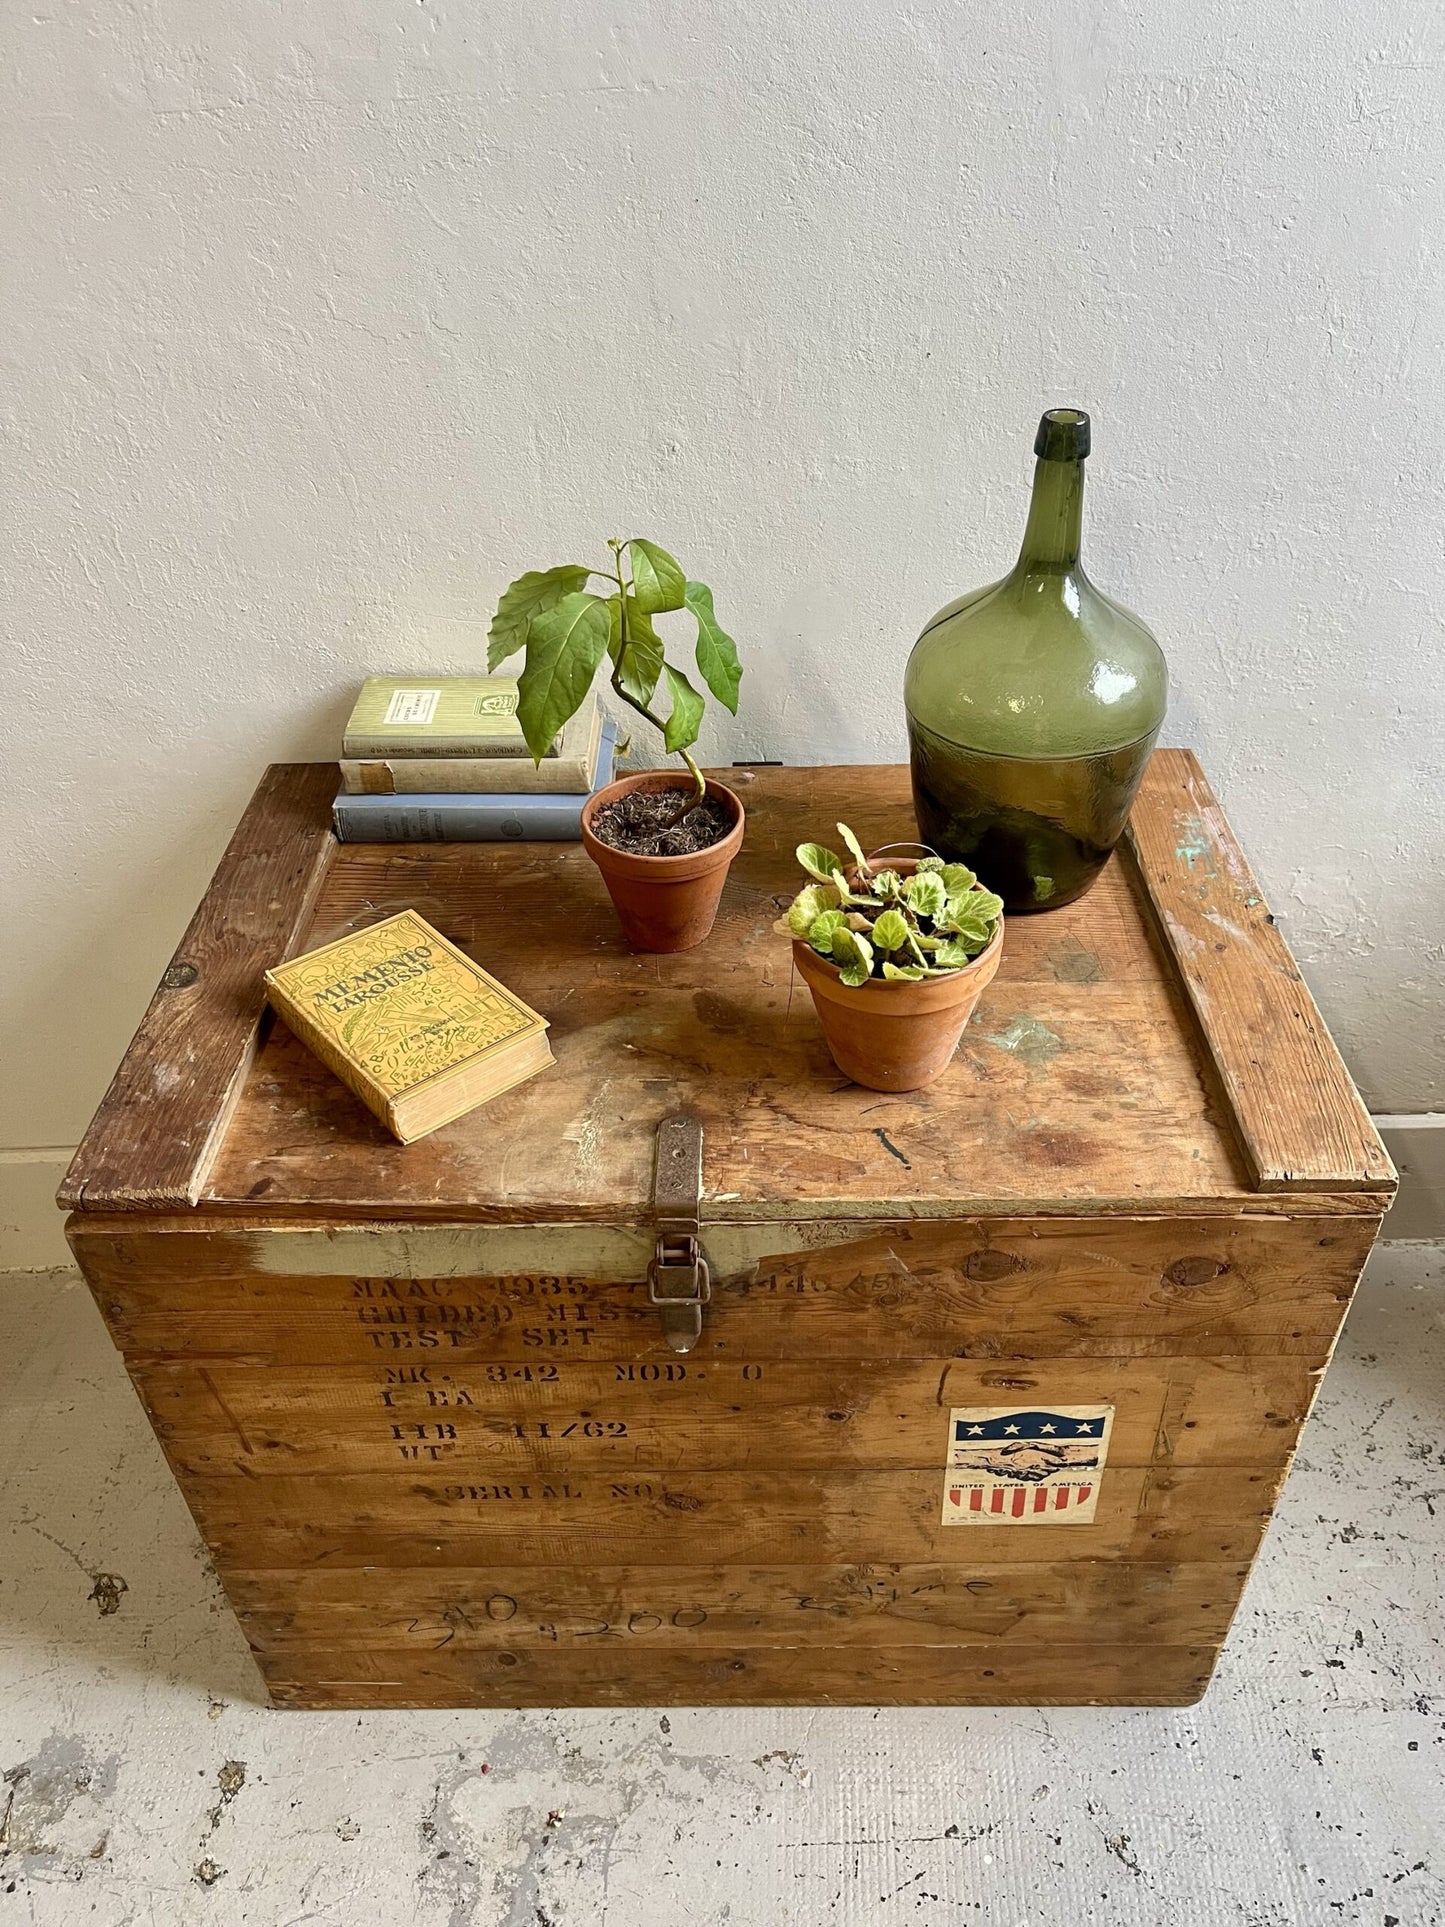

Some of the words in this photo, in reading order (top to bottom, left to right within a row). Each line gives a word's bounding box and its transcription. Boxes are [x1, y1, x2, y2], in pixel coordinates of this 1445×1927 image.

[330, 961, 436, 1013] LAROUSSE
[365, 1329, 463, 1348] TEST
[521, 1328, 595, 1346] SET
[486, 1365, 560, 1382] 342
[445, 1485, 582, 1500] SERIAL
